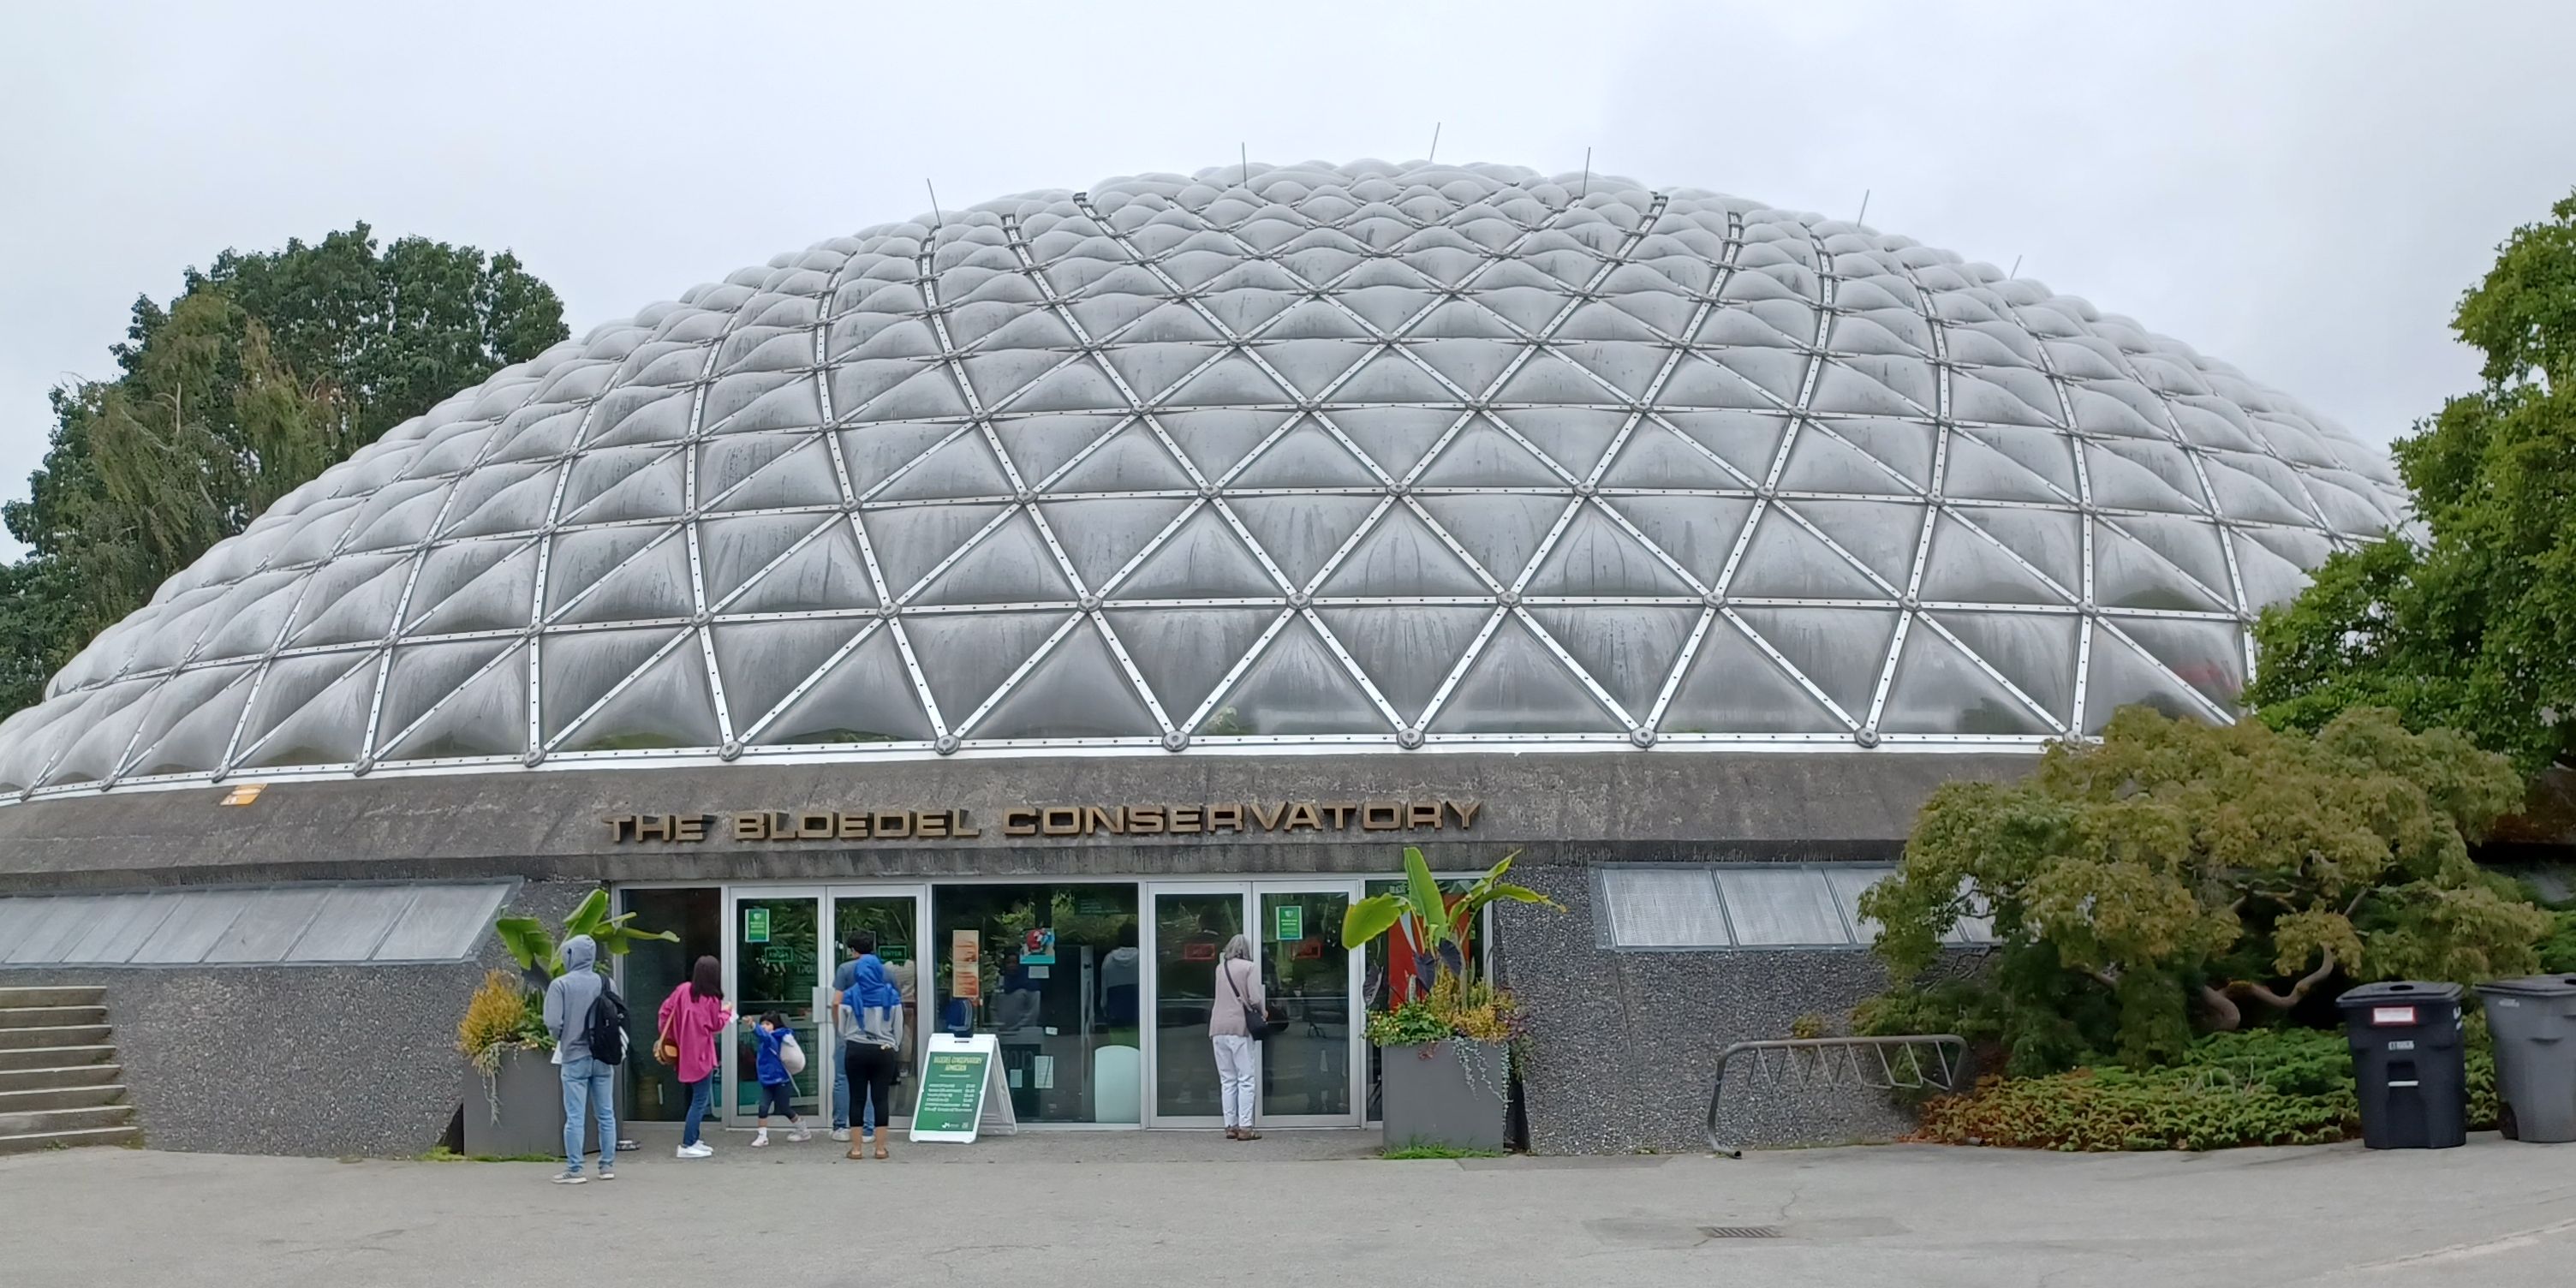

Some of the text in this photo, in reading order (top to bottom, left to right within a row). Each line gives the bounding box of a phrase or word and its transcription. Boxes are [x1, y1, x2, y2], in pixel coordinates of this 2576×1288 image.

[602, 801, 1482, 842] THE BLOEDEL CONSERVATORY
